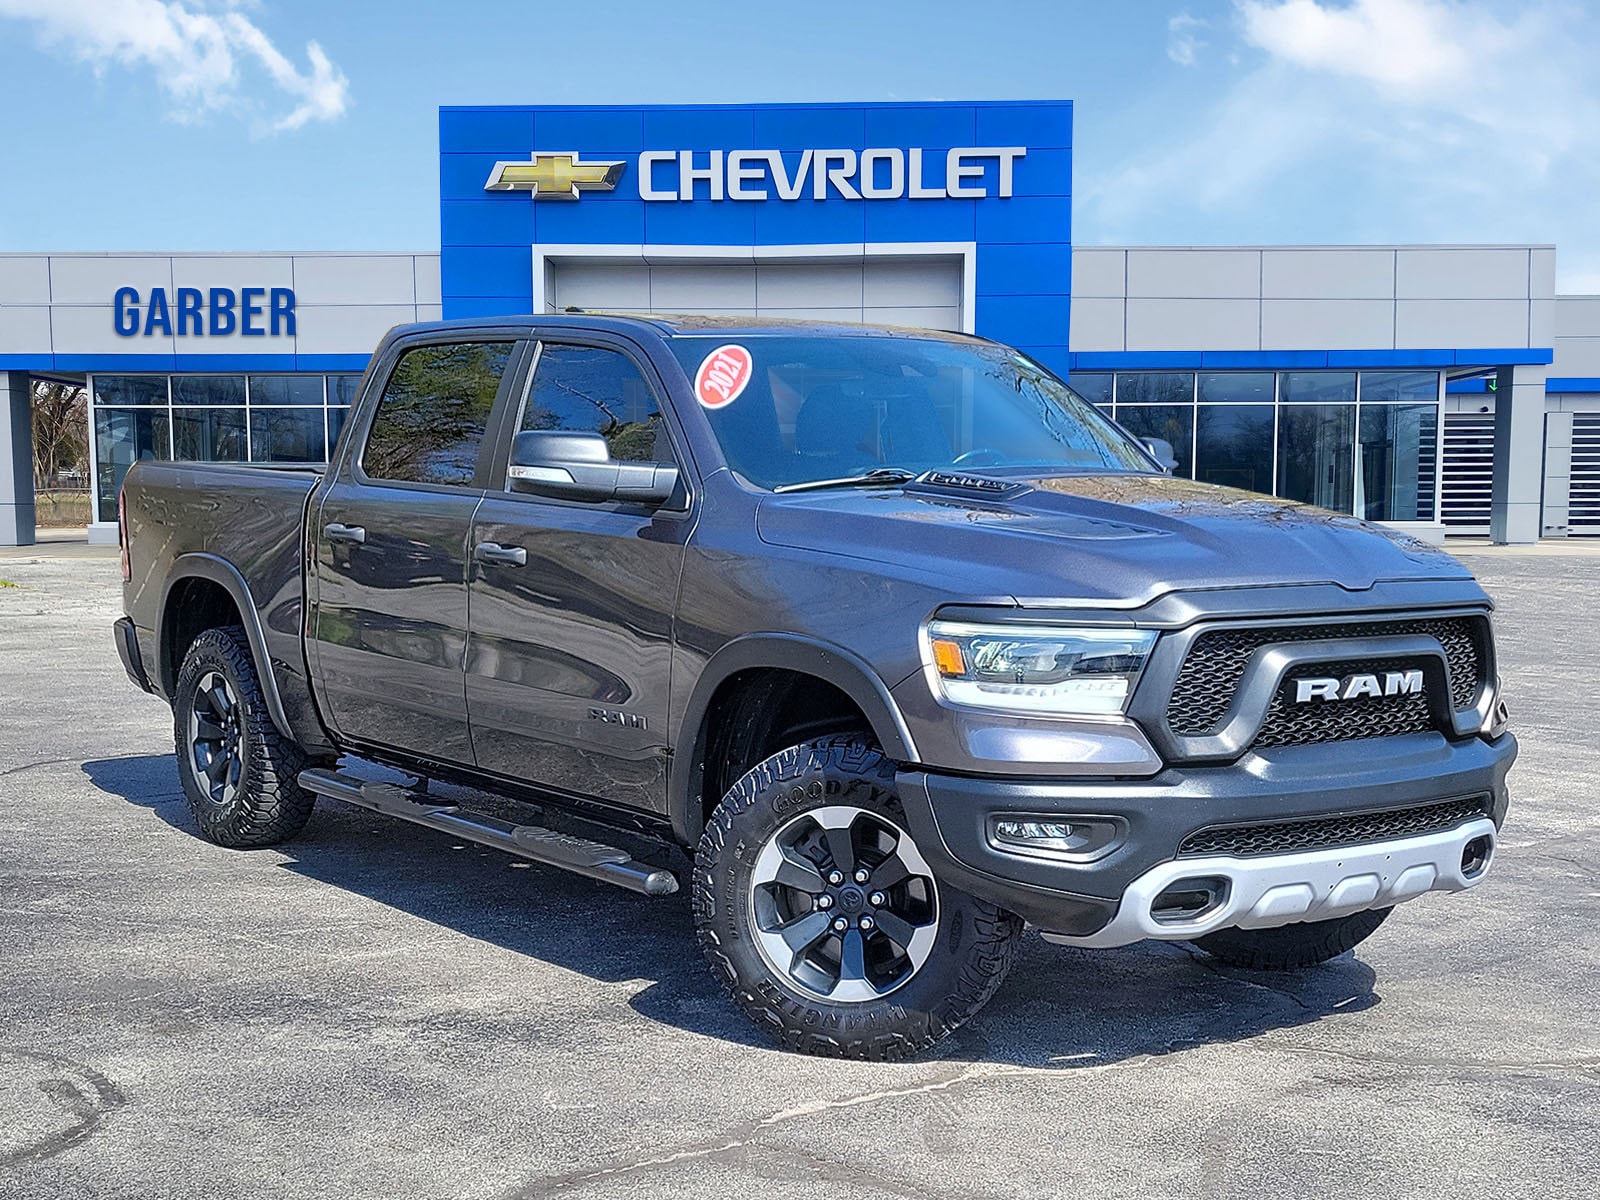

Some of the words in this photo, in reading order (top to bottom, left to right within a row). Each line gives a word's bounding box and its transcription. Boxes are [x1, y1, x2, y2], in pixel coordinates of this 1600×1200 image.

[638, 147, 1027, 201] CHEVROLET
[114, 287, 296, 336] GARBER
[703, 352, 743, 400] 2021
[1294, 669, 1423, 703] RAM
[587, 706, 648, 730] RAM
[772, 779, 908, 824] GOODYE
